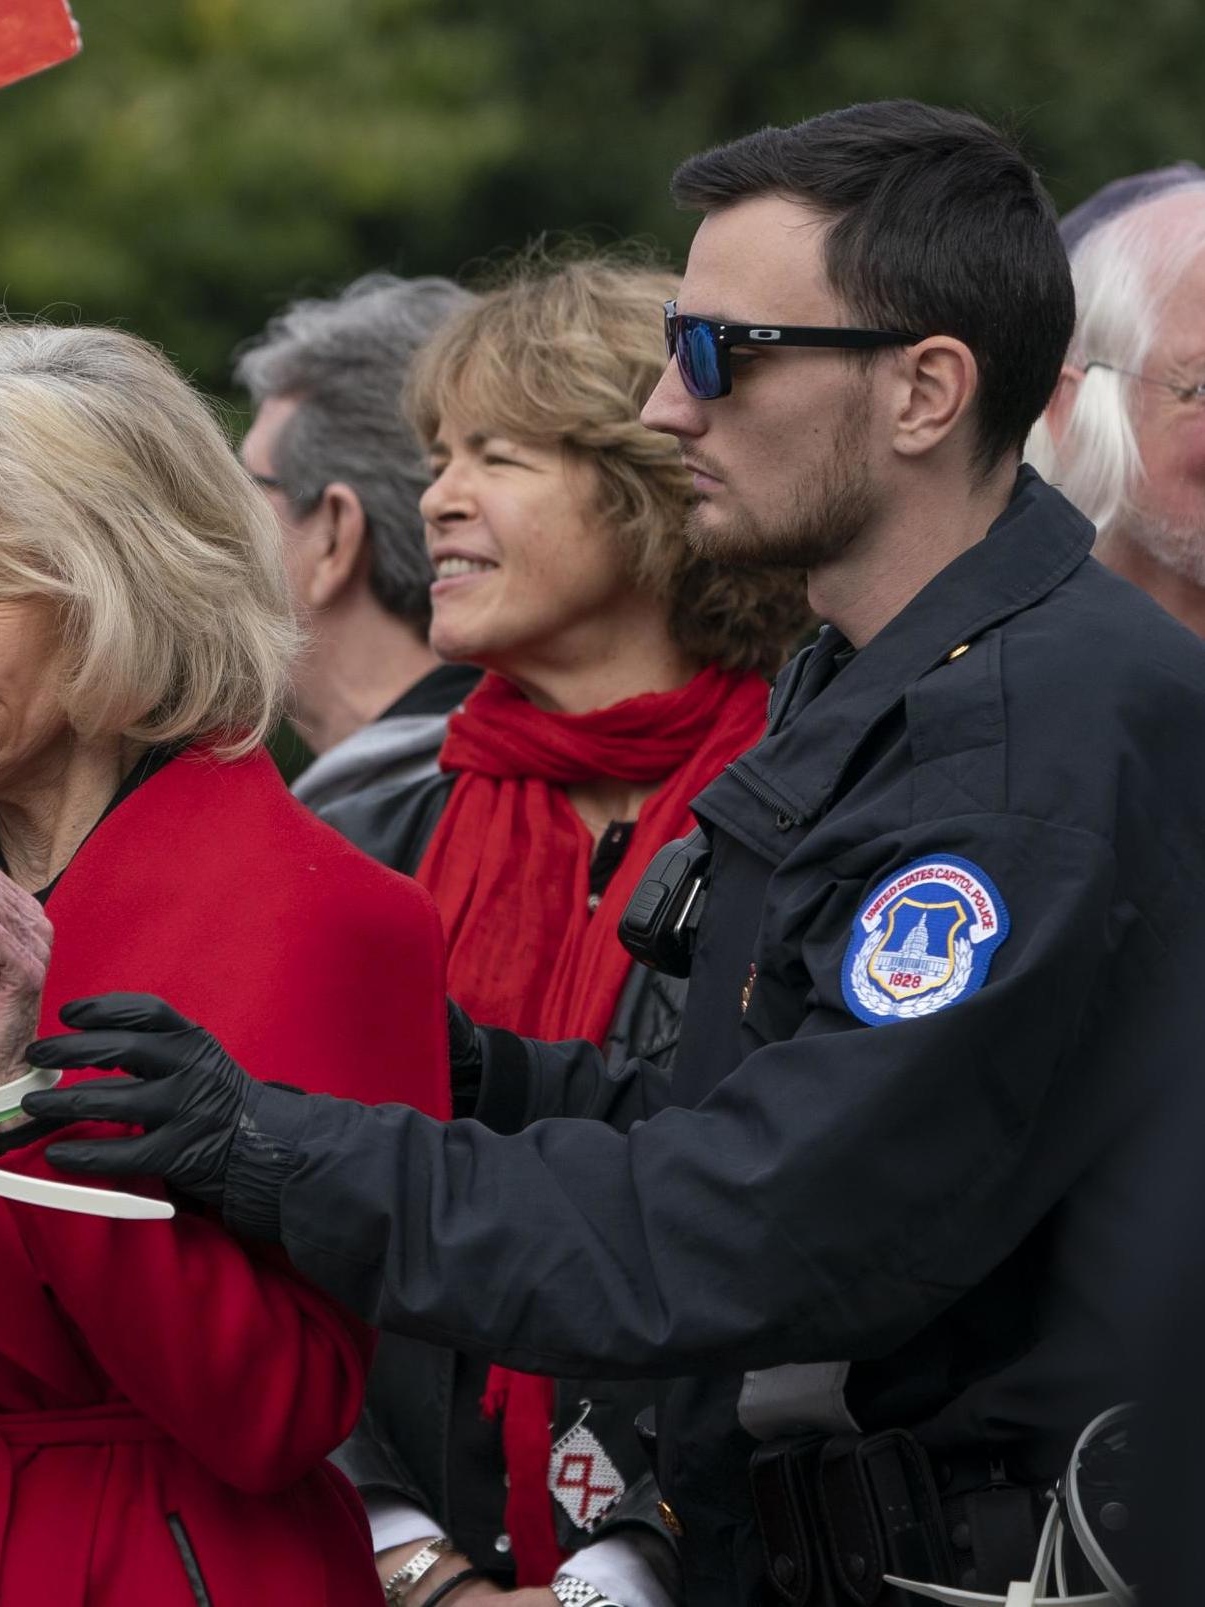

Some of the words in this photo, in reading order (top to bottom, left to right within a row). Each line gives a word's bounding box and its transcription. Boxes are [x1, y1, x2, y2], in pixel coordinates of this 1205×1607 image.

[864, 887, 898, 922] UNITED
[897, 868, 934, 891] STATES
[935, 868, 973, 895] CAPITOL
[971, 889, 994, 931] POLICE
[888, 972, 922, 989] 1828
